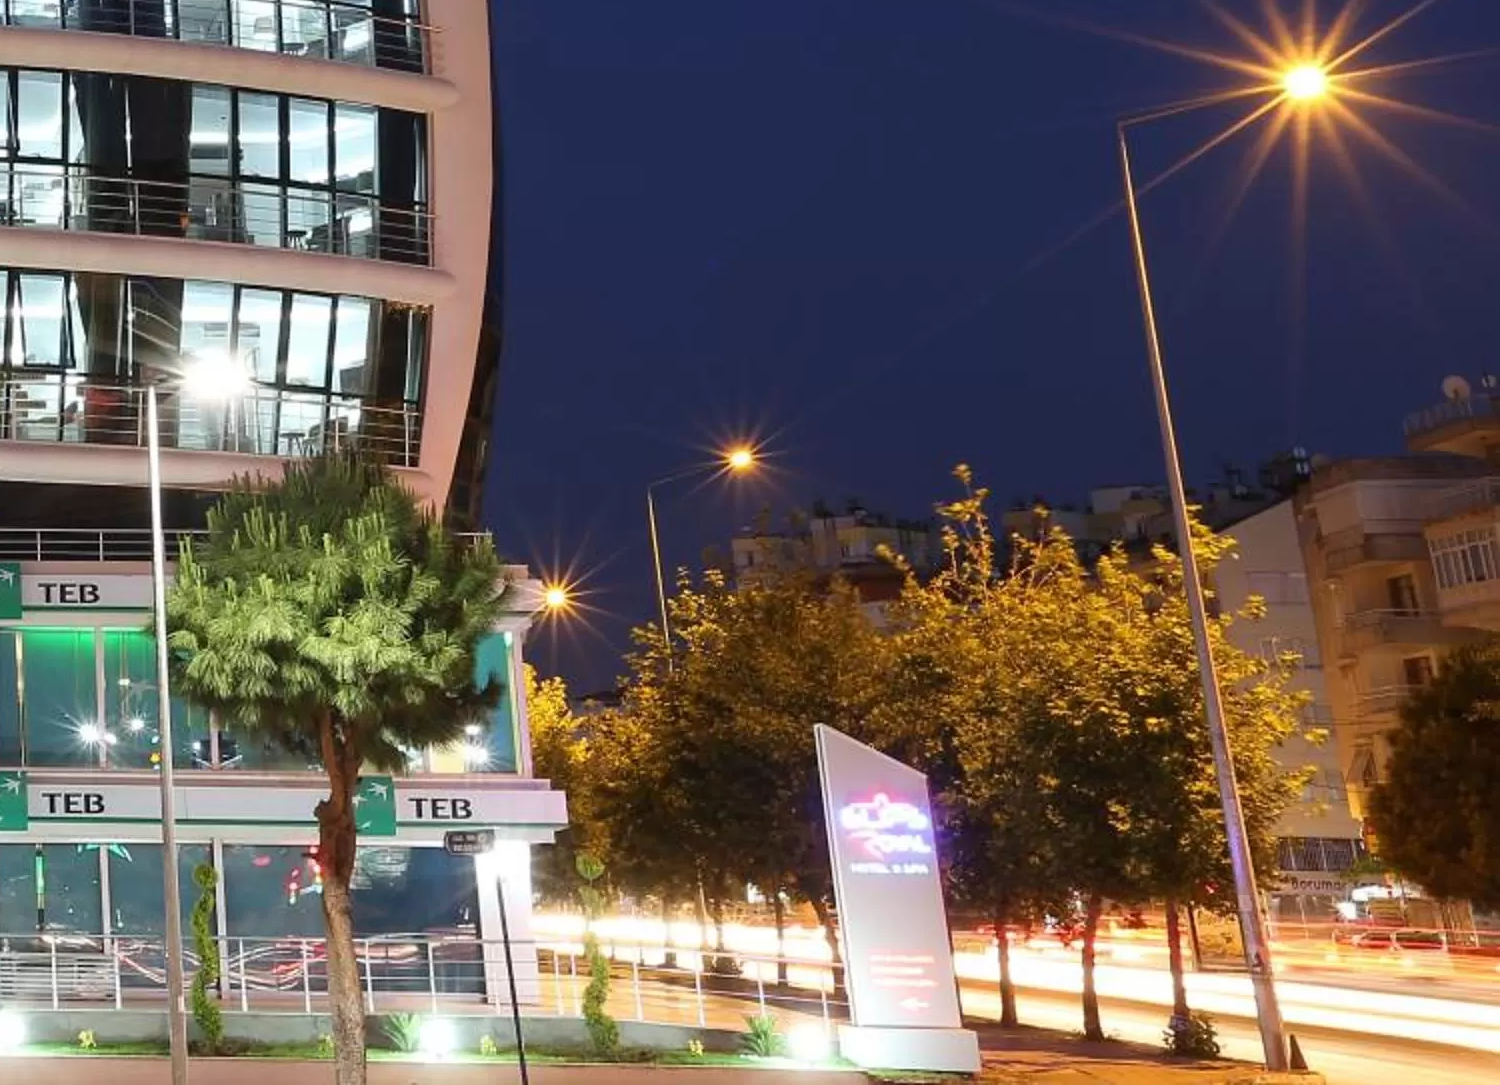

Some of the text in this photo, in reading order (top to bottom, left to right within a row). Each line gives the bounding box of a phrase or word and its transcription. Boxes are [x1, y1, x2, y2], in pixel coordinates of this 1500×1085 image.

[37, 582, 101, 604] TEB
[41, 792, 105, 814] TEB
[407, 797, 473, 820] TEB
